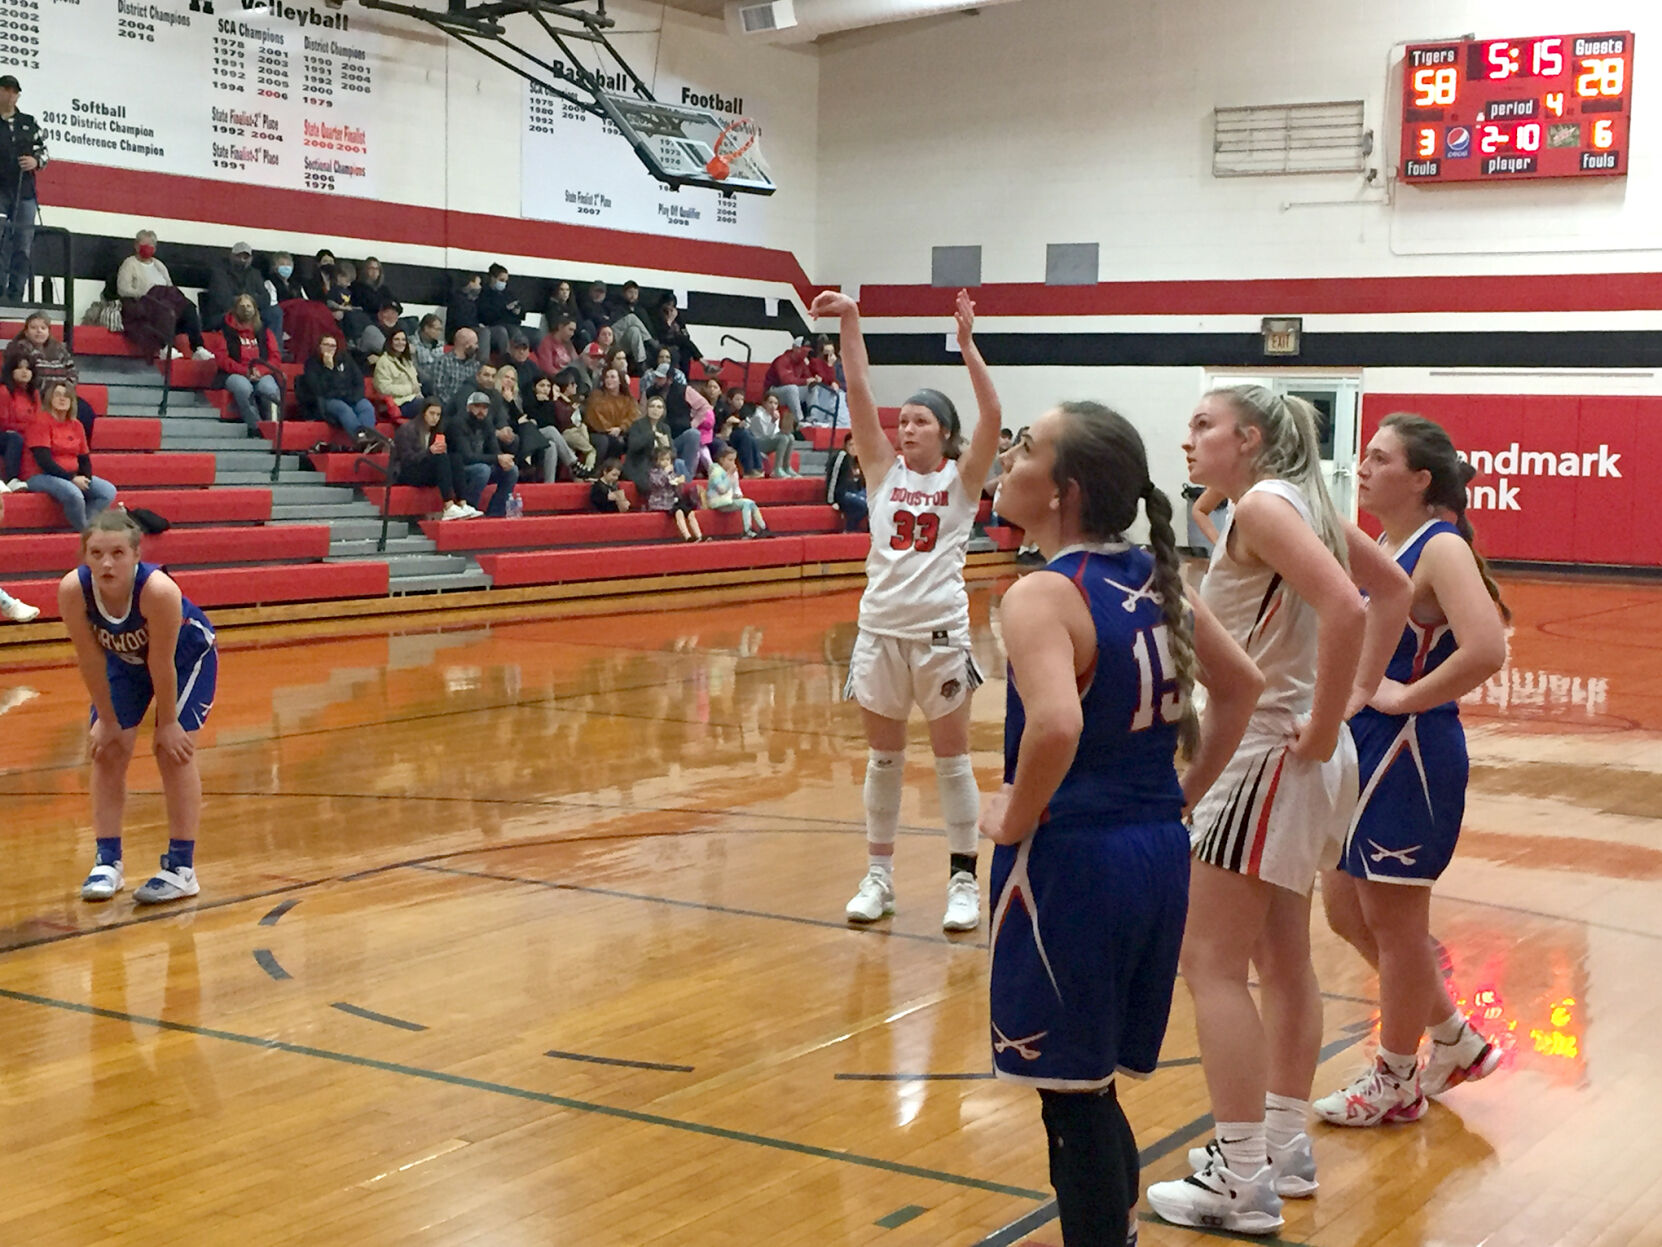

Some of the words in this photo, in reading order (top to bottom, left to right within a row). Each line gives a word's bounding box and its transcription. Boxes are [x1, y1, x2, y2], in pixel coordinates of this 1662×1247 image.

[0, 8, 39, 22] 2002
[118, 0, 148, 19] District
[150, 5, 191, 27] Champions
[241, 0, 349, 31] Volleyball
[0, 19, 39, 33] 2004
[118, 19, 155, 32] 2004
[218, 18, 236, 35] SCA
[239, 23, 284, 45] Champions
[0, 31, 39, 45] 2005
[118, 29, 155, 43] 2016
[304, 35, 329, 54] District
[0, 44, 39, 57] 2007
[258, 46, 289, 59] 2001
[1575, 39, 1624, 56] Guests
[0, 56, 39, 69] 2013
[1412, 49, 1455, 66] Tigers
[1489, 38, 1563, 79] 5:15
[257, 66, 289, 78] 2004
[341, 62, 371, 75] 2001
[553, 60, 627, 91] Baball
[1577, 57, 1624, 97] 28
[212, 81, 244, 93] 1994
[257, 88, 288, 100] 2006
[302, 84, 333, 96] 2000
[1414, 67, 1457, 106] 58
[72, 98, 126, 118] Softball
[303, 96, 333, 108] 1979
[681, 87, 743, 115] Football
[1490, 100, 1533, 120] period
[1546, 92, 1563, 117] 4
[43, 110, 68, 125] 2012
[70, 114, 107, 132] District
[109, 120, 154, 138] Champion
[212, 124, 245, 137] 1992
[251, 130, 283, 142] 2004
[1419, 129, 1435, 156] 3
[1594, 119, 1612, 148] 6
[64, 130, 118, 150] Conference
[119, 138, 165, 156] Champion
[304, 138, 334, 150] 2000
[336, 143, 367, 154] 2001
[212, 159, 246, 170] 1991
[1407, 161, 1437, 176] fouls
[1488, 156, 1530, 174] player
[1583, 153, 1615, 169] fouls
[1272, 335, 1289, 348] EXIT
[889, 487, 949, 507] HOUSTON
[1465, 478, 1521, 510] nk
[890, 510, 940, 552] 33
[1128, 623, 1183, 733] 15
